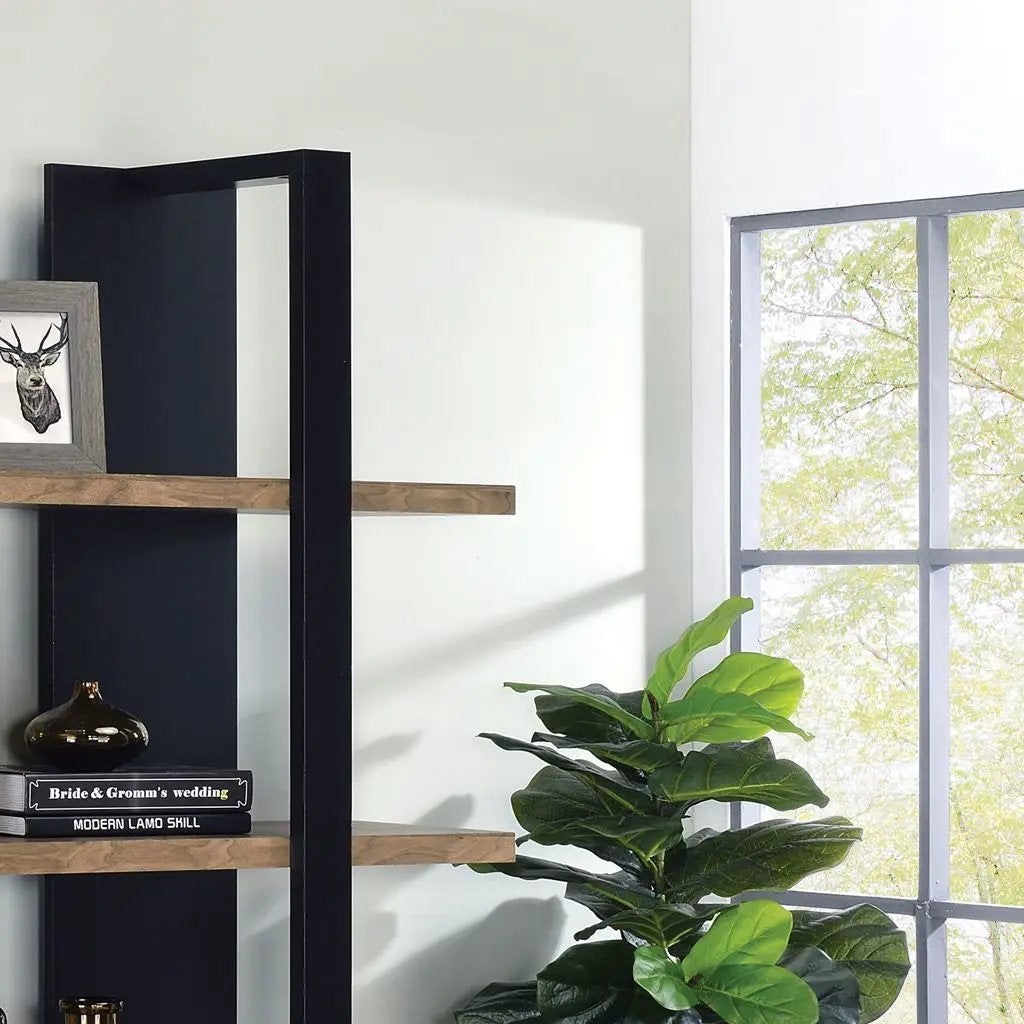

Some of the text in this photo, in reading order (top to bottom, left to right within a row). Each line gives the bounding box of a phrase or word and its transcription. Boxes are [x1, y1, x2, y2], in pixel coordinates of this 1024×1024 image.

[49, 786, 229, 800] Bride & Gromm's wedding
[73, 818, 125, 831] MODERN
[167, 816, 201, 829] SKILL
